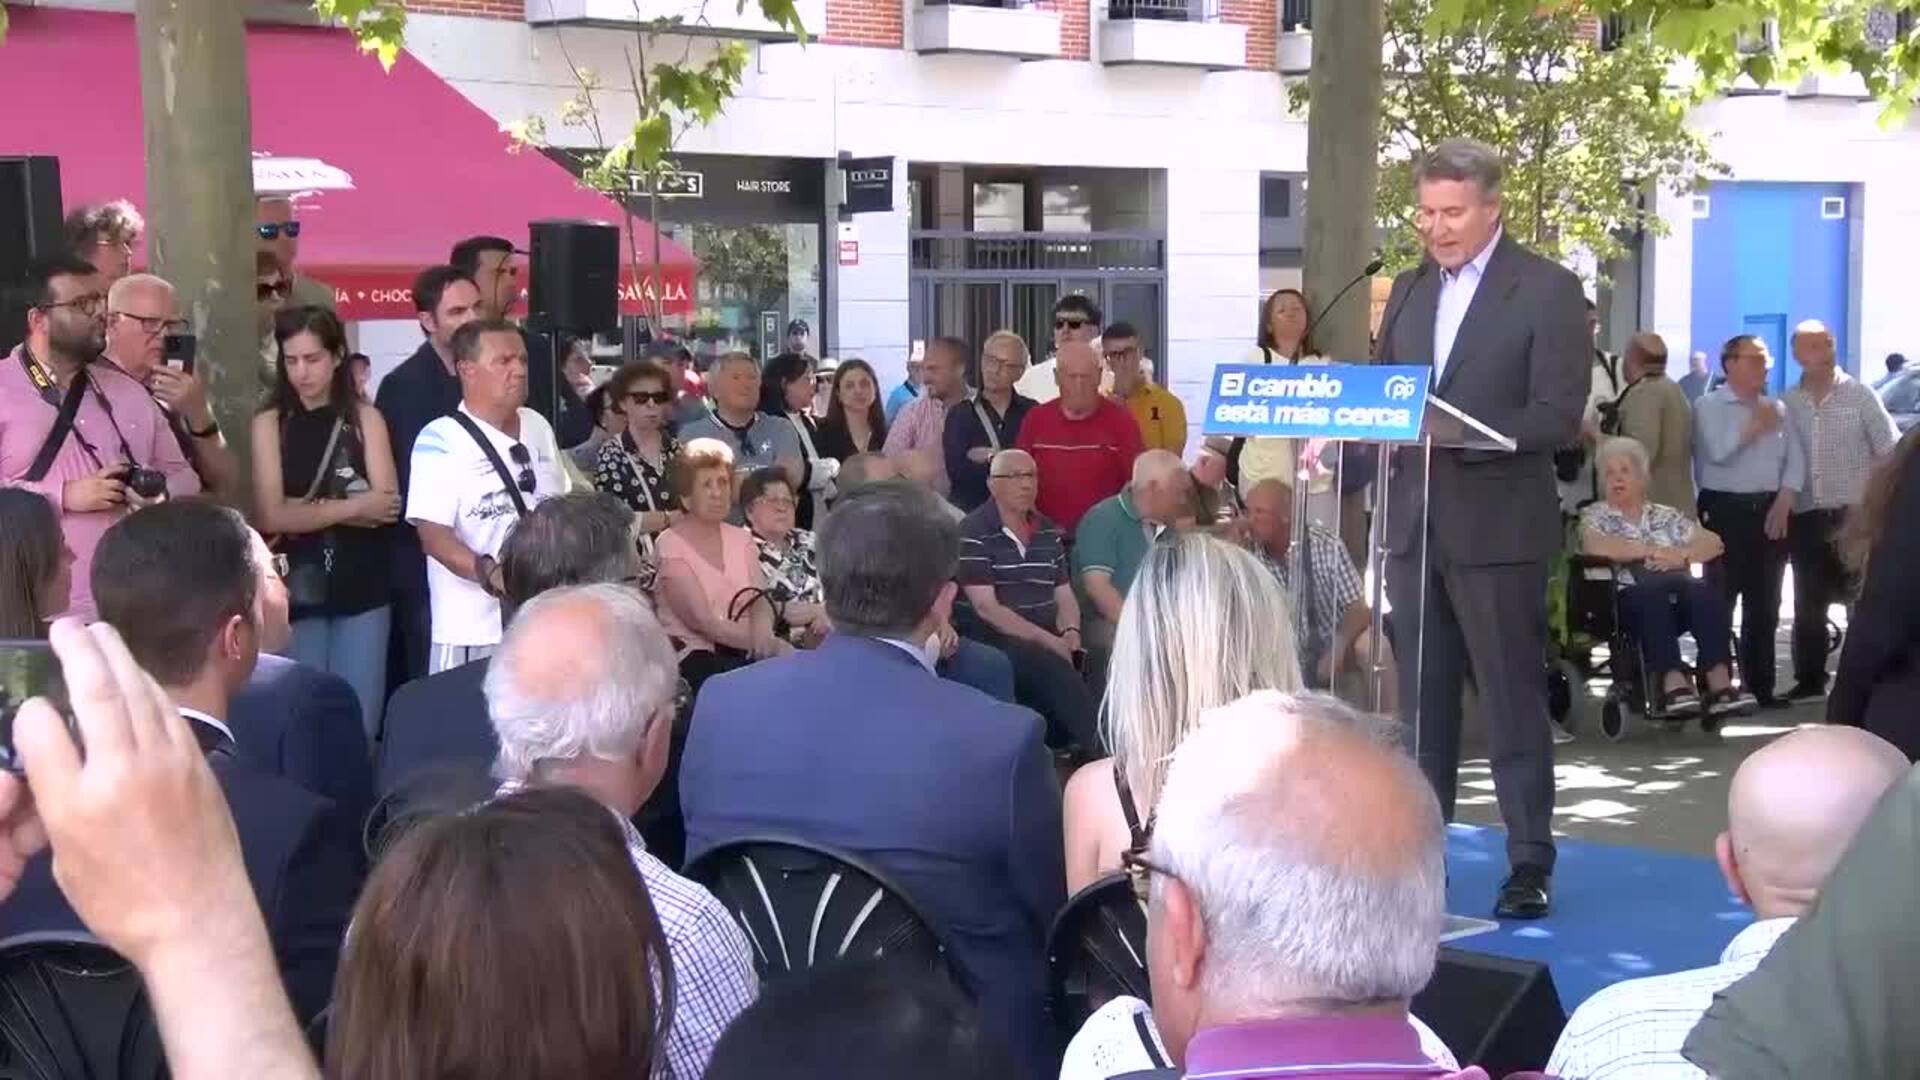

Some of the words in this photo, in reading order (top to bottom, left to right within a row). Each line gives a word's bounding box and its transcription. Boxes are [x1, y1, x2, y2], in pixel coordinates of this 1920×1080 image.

[736, 180, 760, 192] HAIR
[761, 180, 791, 192] STORE
[1219, 372, 1246, 396] El
[1247, 372, 1342, 398] cambio
[1214, 399, 1269, 423] está
[1272, 401, 1331, 426] más
[1333, 406, 1411, 428] cerca
